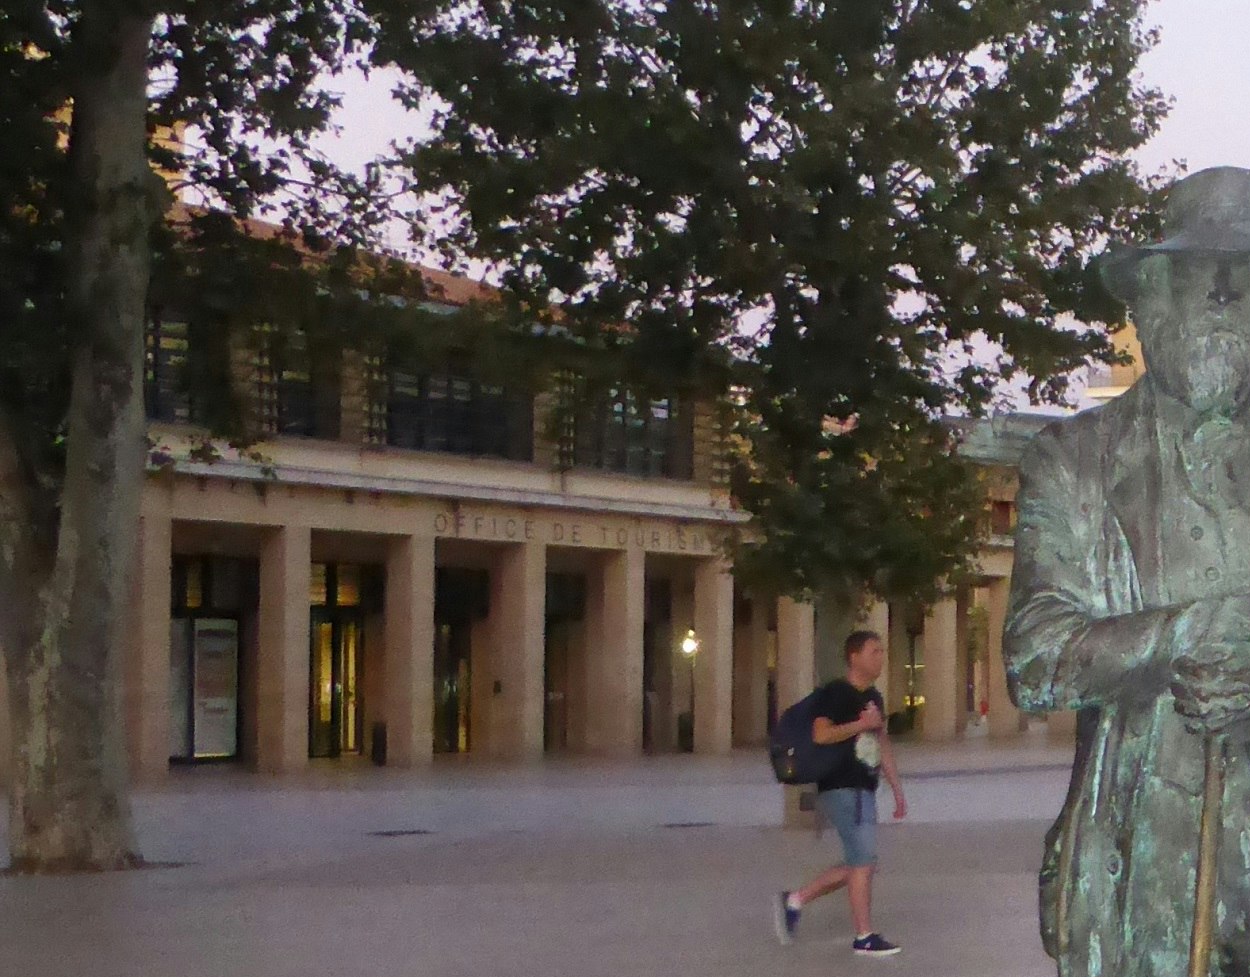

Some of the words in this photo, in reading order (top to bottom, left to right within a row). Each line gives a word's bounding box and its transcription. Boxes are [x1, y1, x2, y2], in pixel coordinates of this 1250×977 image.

[434, 513, 535, 540] OFFICE
[552, 521, 583, 544] DE
[600, 526, 722, 553] TOURISM
